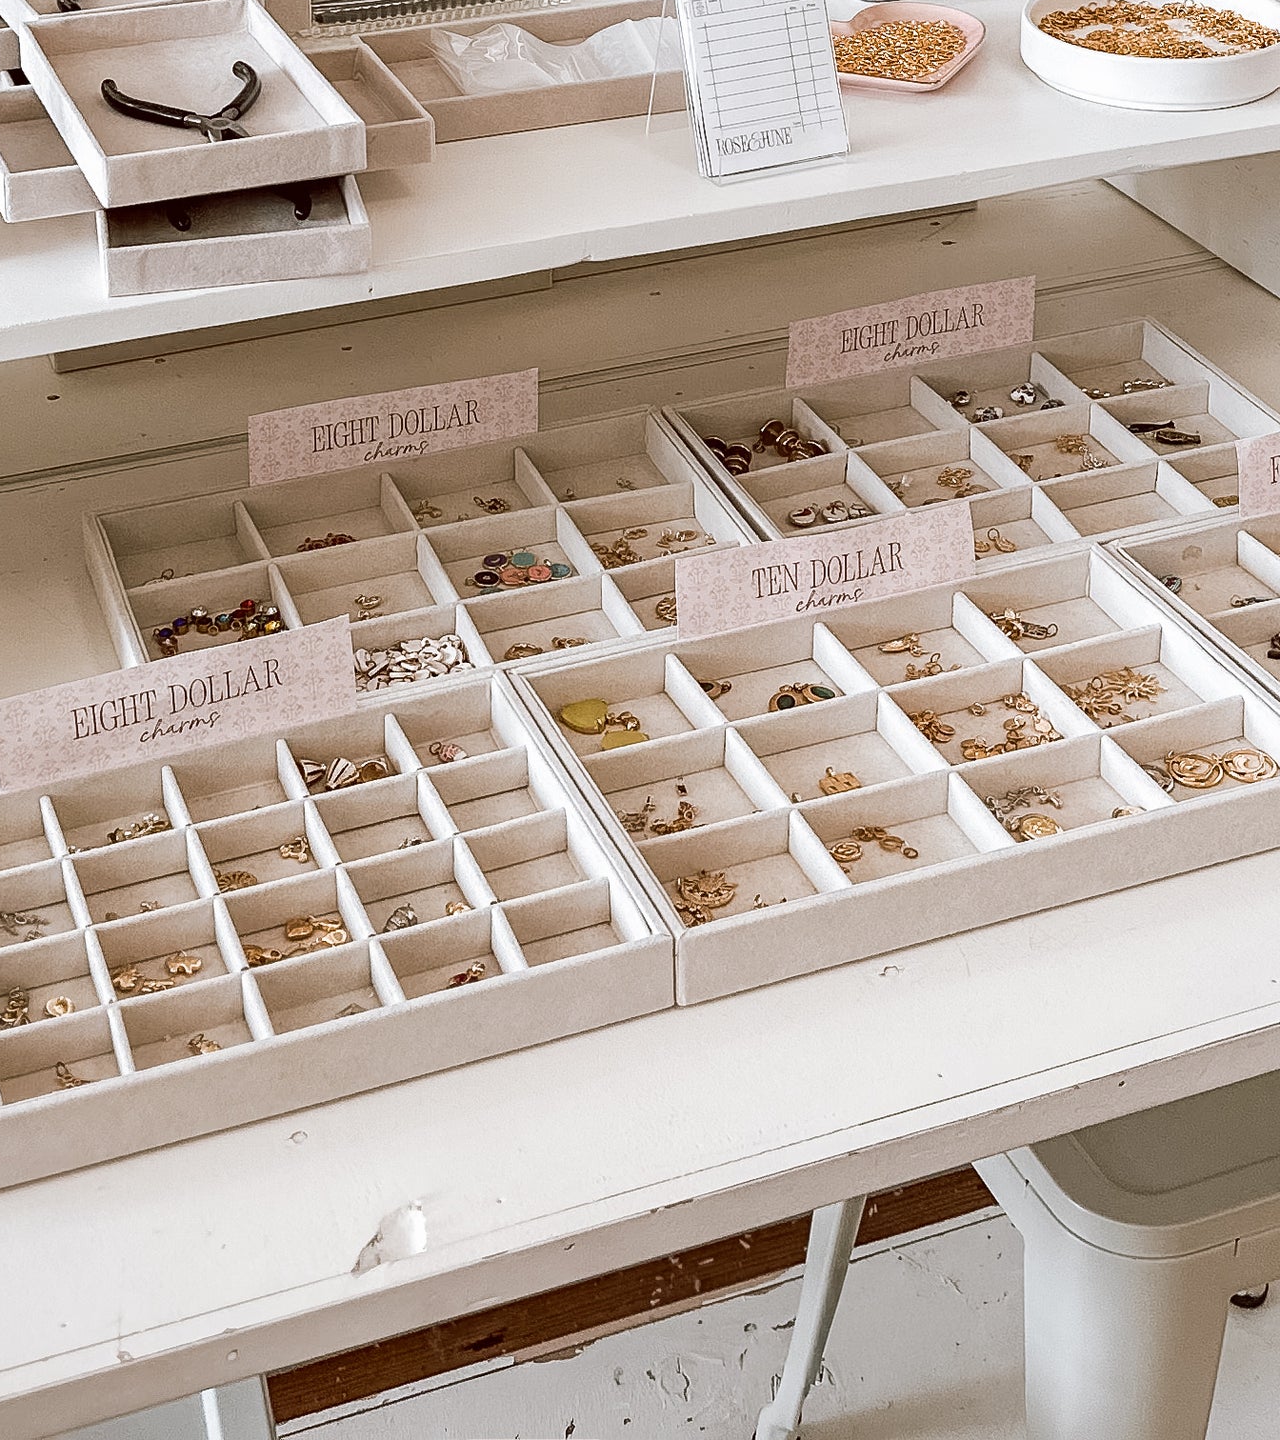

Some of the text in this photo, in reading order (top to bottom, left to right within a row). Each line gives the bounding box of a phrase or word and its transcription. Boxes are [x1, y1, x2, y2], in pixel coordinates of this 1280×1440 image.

[716, 127, 792, 156] ROSE&JUNE
[840, 303, 985, 354] EIGHT DOLLAR
[884, 341, 939, 362] charms
[311, 399, 480, 453] EIGHT DOLLAR
[364, 439, 428, 461] charms
[752, 542, 904, 599] TEN DOLLAR
[796, 588, 863, 612] charms
[71, 658, 283, 740] EIGHT DOLLAR
[140, 711, 220, 743] charms
